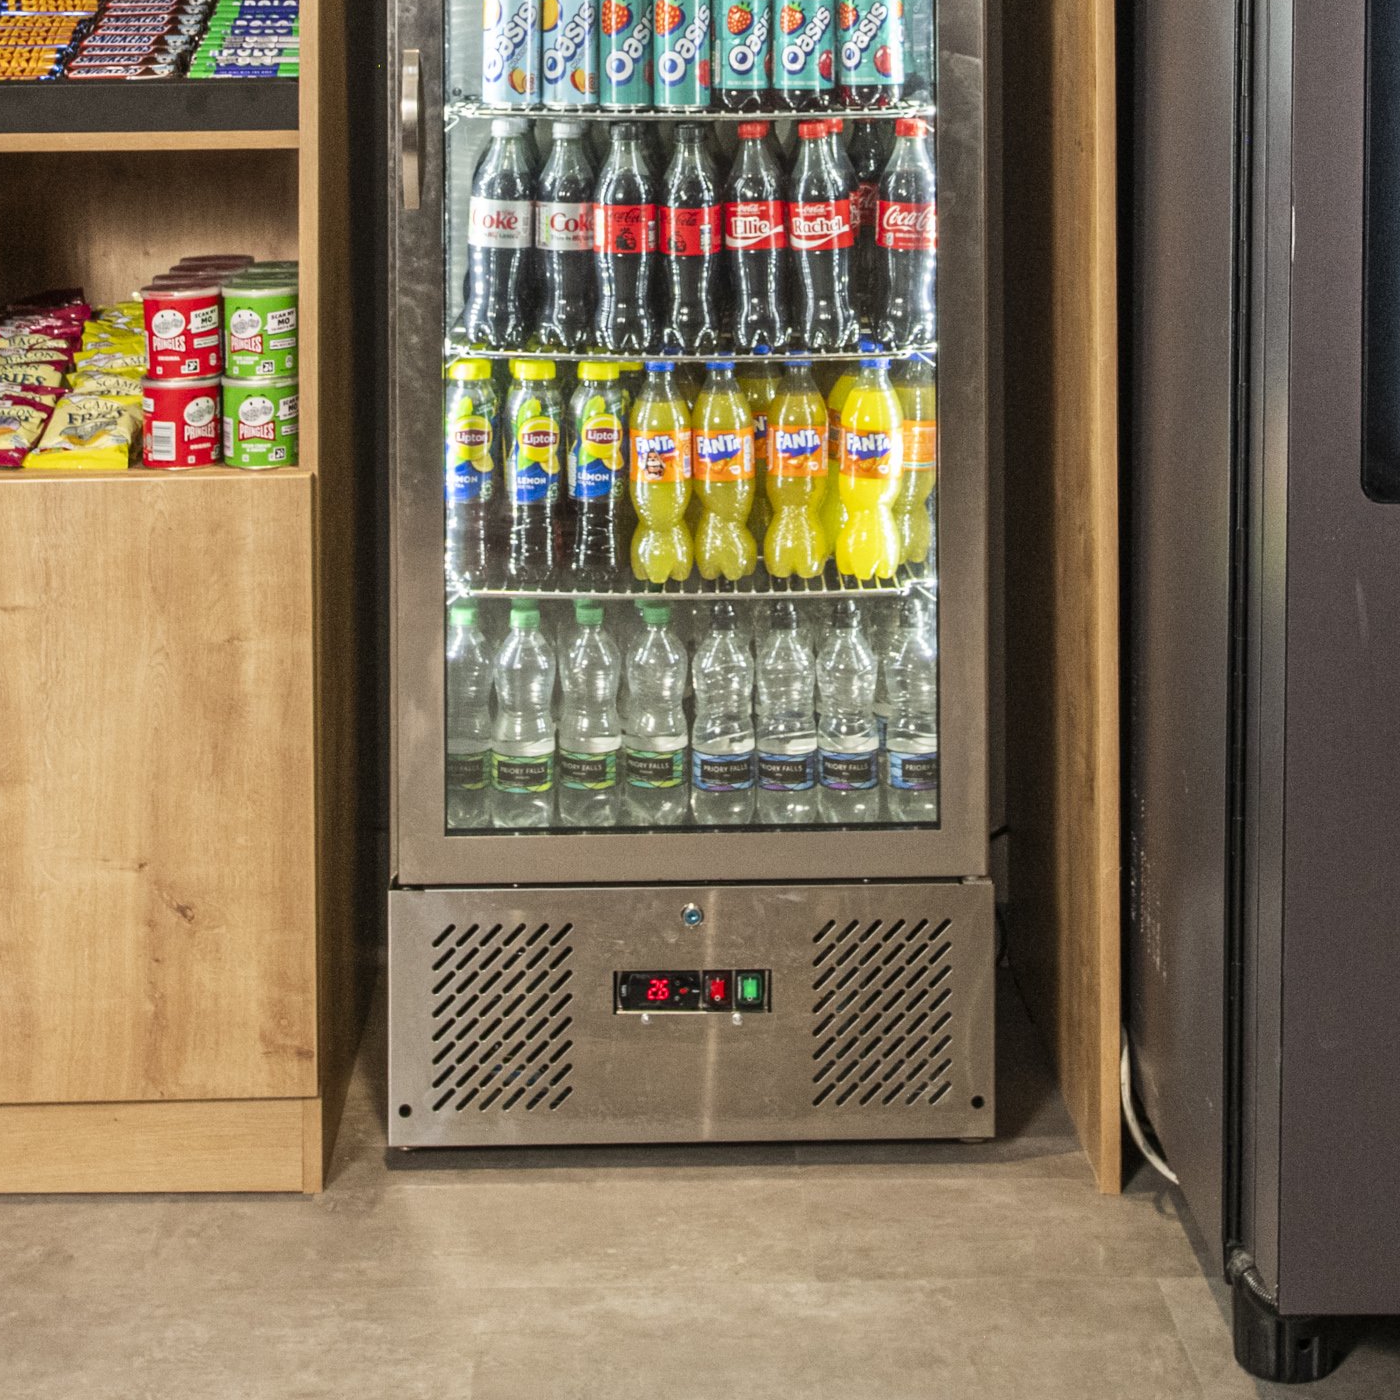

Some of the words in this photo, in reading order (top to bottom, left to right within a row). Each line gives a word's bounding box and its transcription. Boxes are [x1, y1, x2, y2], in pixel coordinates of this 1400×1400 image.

[104, 16, 166, 24] SNICKERS
[87, 35, 152, 44] SNICKERS
[543, 2, 595, 80] Oasis
[659, 5, 711, 81] Oasis
[782, 6, 831, 73] Oasis
[76, 56, 140, 64] SNICKERS
[732, 217, 770, 236] Ellie
[793, 217, 843, 234] Rachel
[153, 335, 186, 352] PRINGLES
[231, 334, 264, 353] PRINGLES
[184, 421, 216, 442] PRINGLES
[239, 422, 275, 440] PRINGLES
[456, 431, 490, 446] Lipton
[586, 428, 619, 443] Lipton
[635, 435, 676, 453] FANTA
[696, 434, 741, 454] FANTA
[775, 430, 820, 451] FANTA
[517, 476, 547, 485] LEMON
[578, 472, 609, 482] LEMON
[703, 764, 728, 773] PRIORY
[729, 763, 748, 772] FALLS
[905, 764, 930, 772] PRIORY
